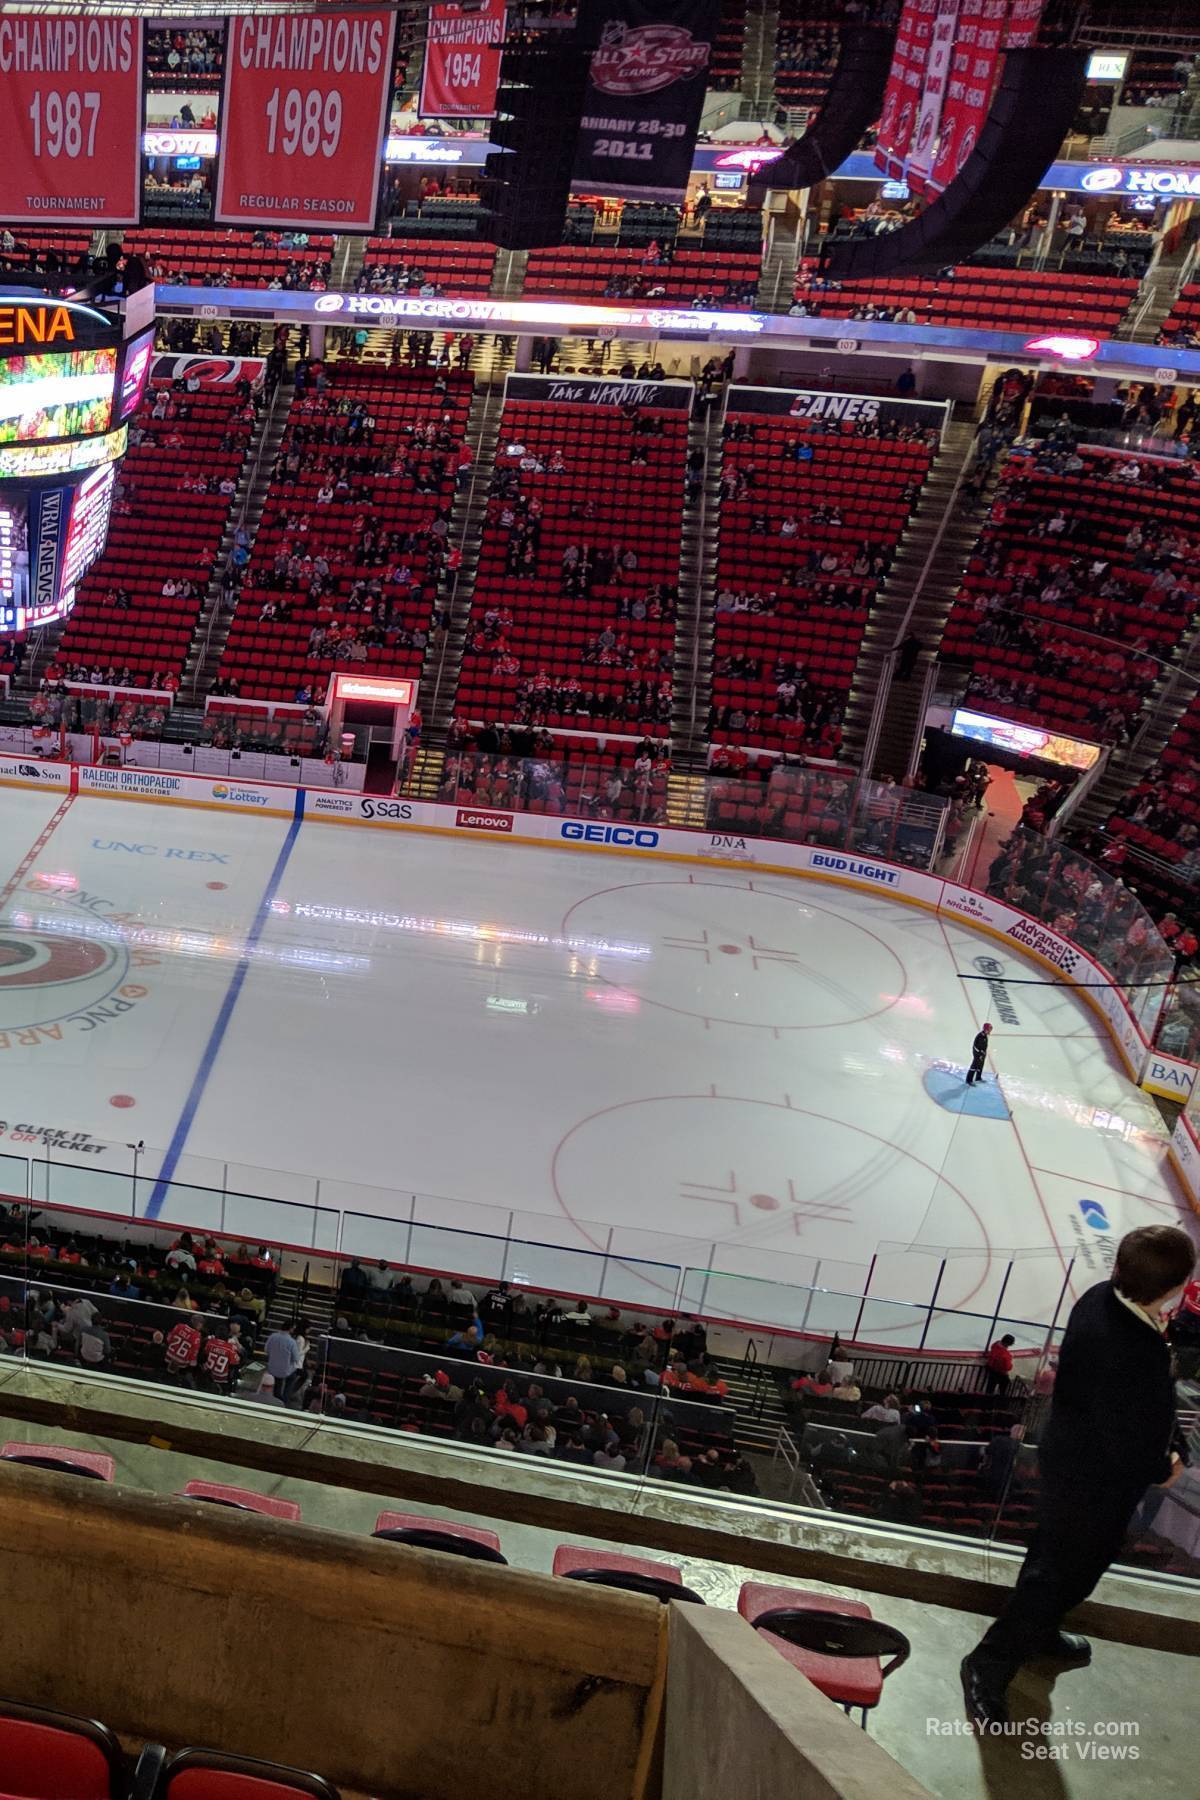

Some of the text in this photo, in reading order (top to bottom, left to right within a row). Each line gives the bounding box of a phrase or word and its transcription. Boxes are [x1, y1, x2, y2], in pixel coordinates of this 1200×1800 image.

[432, 18, 500, 44] CHAMPIONS
[0, 19, 132, 72] CHAMPIONS
[240, 17, 383, 74] CHAMPIONS
[648, 47, 705, 65] STAR
[444, 54, 480, 88] 1954
[618, 68, 660, 77] GAME
[30, 91, 100, 157] 1987
[266, 88, 342, 157] 1989
[580, 117, 687, 138] ANUARY 28-30
[592, 139, 653, 160] 2011
[27, 197, 105, 210] TOURNAMENT
[240, 195, 355, 213] REGULAR SEASON
[204, 307, 215, 315] 104
[382, 316, 395, 324] 105
[840, 341, 854, 349] 107
[548, 382, 663, 405] TAKE WARNING
[789, 395, 880, 422] CANES
[40, 492, 60, 545] WRAL
[37, 545, 55, 604] NEWS
[42, 768, 61, 780] Son
[82, 768, 180, 790] RALEIGH ORTHOPAEDIC
[90, 781, 170, 796] OFFICIAL TEAM DOCTORS
[230, 791, 270, 805] Lottery
[315, 803, 343, 811] POWERED
[316, 797, 353, 807] ANALYTICS
[460, 813, 509, 828] Lenovo
[561, 822, 659, 848] GEICO
[711, 835, 747, 849] DNA
[92, 839, 232, 865] UNC REX
[813, 855, 897, 883] BUD LIGHT
[1006, 926, 1060, 963] Auto Parts
[1016, 919, 1065, 954] Advance
[67, 997, 136, 1031] PNC
[10, 1133, 107, 1154] OR TICKET
[14, 1124, 92, 1142] CLICK IT
[168, 1335, 191, 1358] 26
[207, 1352, 229, 1373] 59
